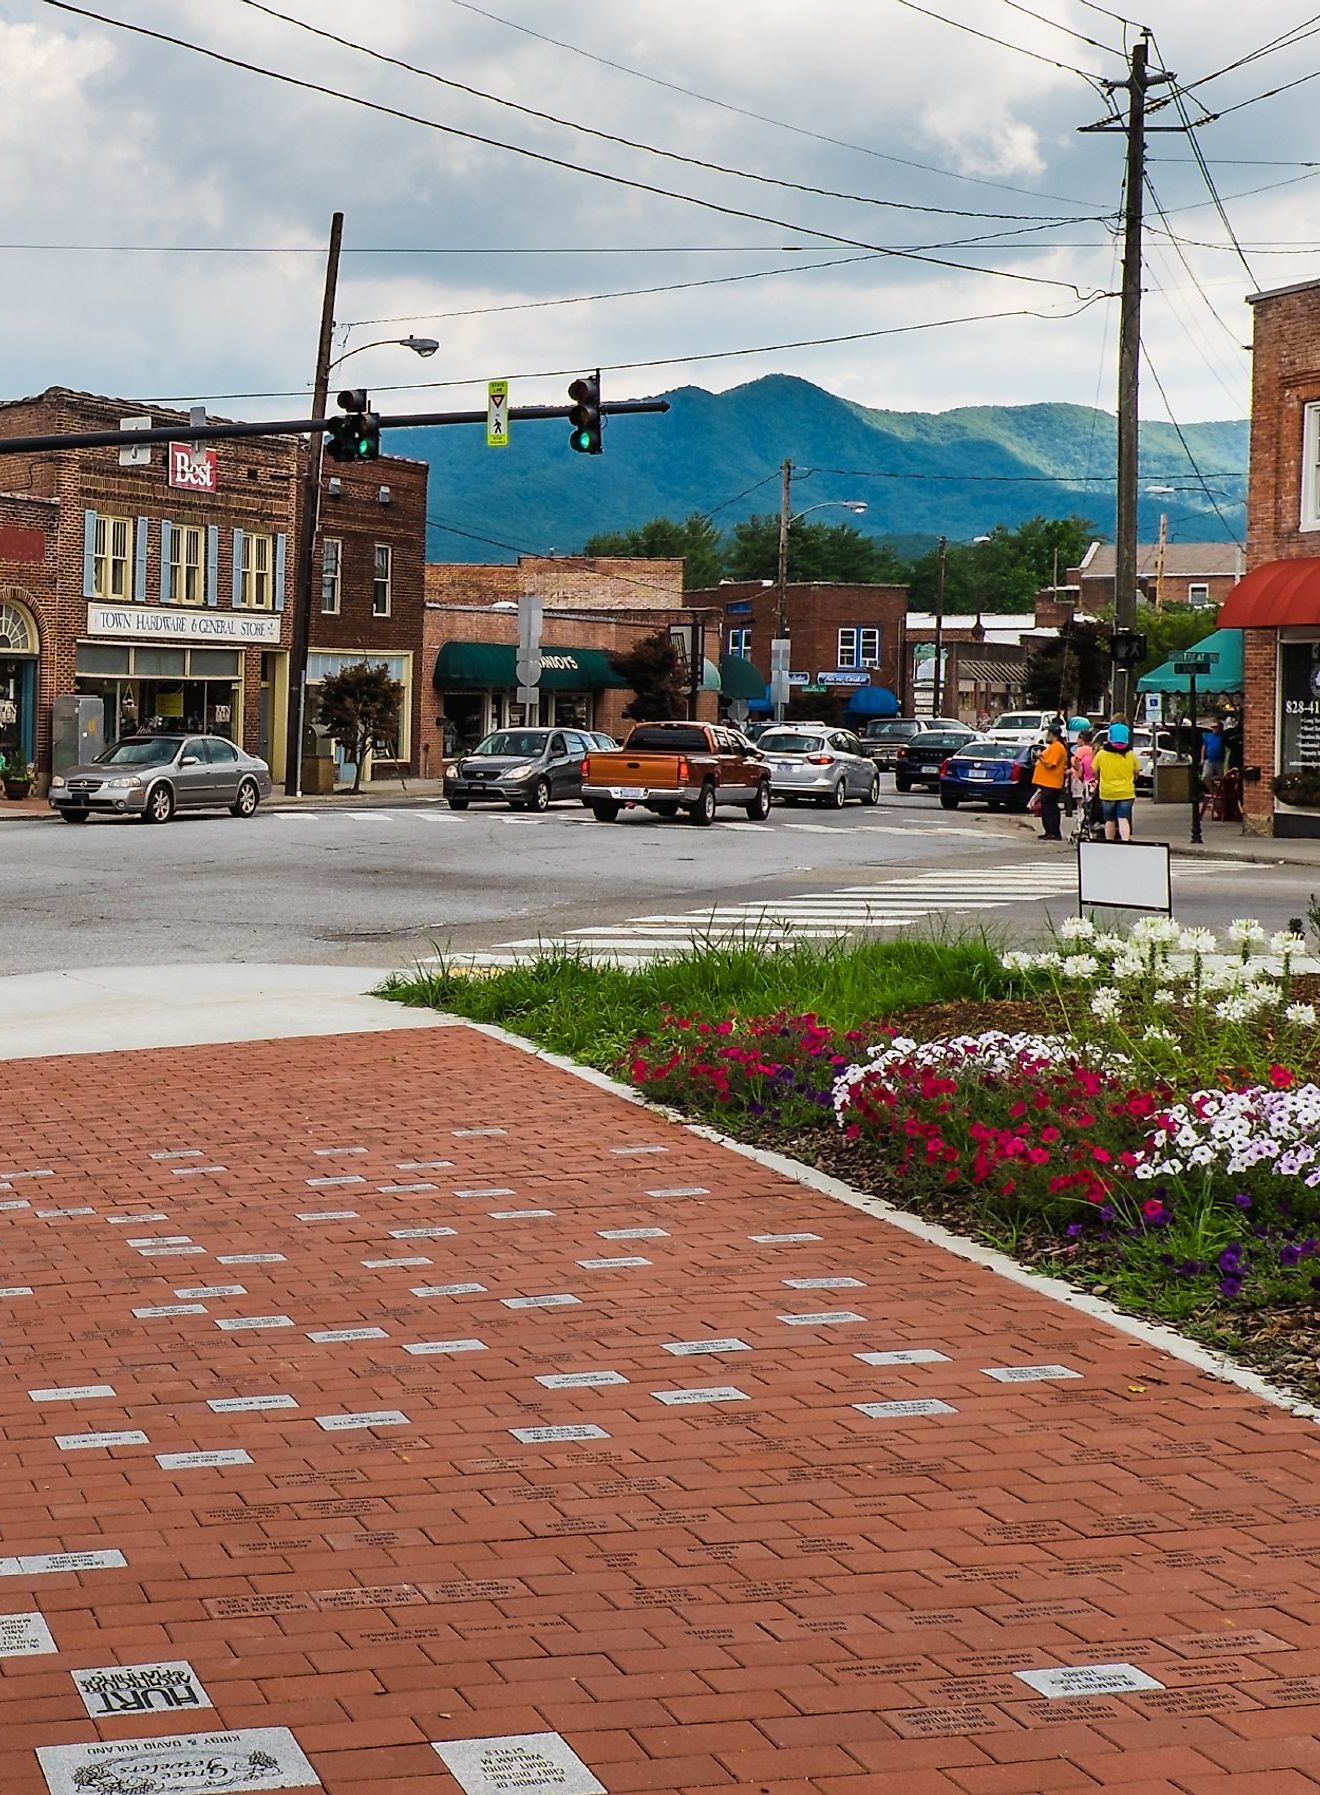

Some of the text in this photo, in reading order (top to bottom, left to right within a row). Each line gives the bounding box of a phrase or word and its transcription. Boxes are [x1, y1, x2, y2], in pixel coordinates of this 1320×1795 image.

[175, 451, 213, 486] Best
[100, 612, 131, 628] TOWN
[136, 614, 186, 632] HARDWARE
[199, 619, 235, 634] GENERAL
[240, 622, 265, 636] STORE
[96, 1686, 199, 1713] HURT
[143, 1740, 181, 1750] DAVID
[203, 1734, 240, 1745] KIRBY
[86, 1743, 138, 1755] RULAND
[497, 1753, 543, 1763] WILLIAM
[120, 1757, 222, 1775] Jewelers
[480, 1761, 554, 1773] COURT JUDGE
[160, 1764, 228, 1781] Grace
[483, 1768, 565, 1780] CHIEF DISTRICT
[512, 1777, 551, 1786] HONOR
